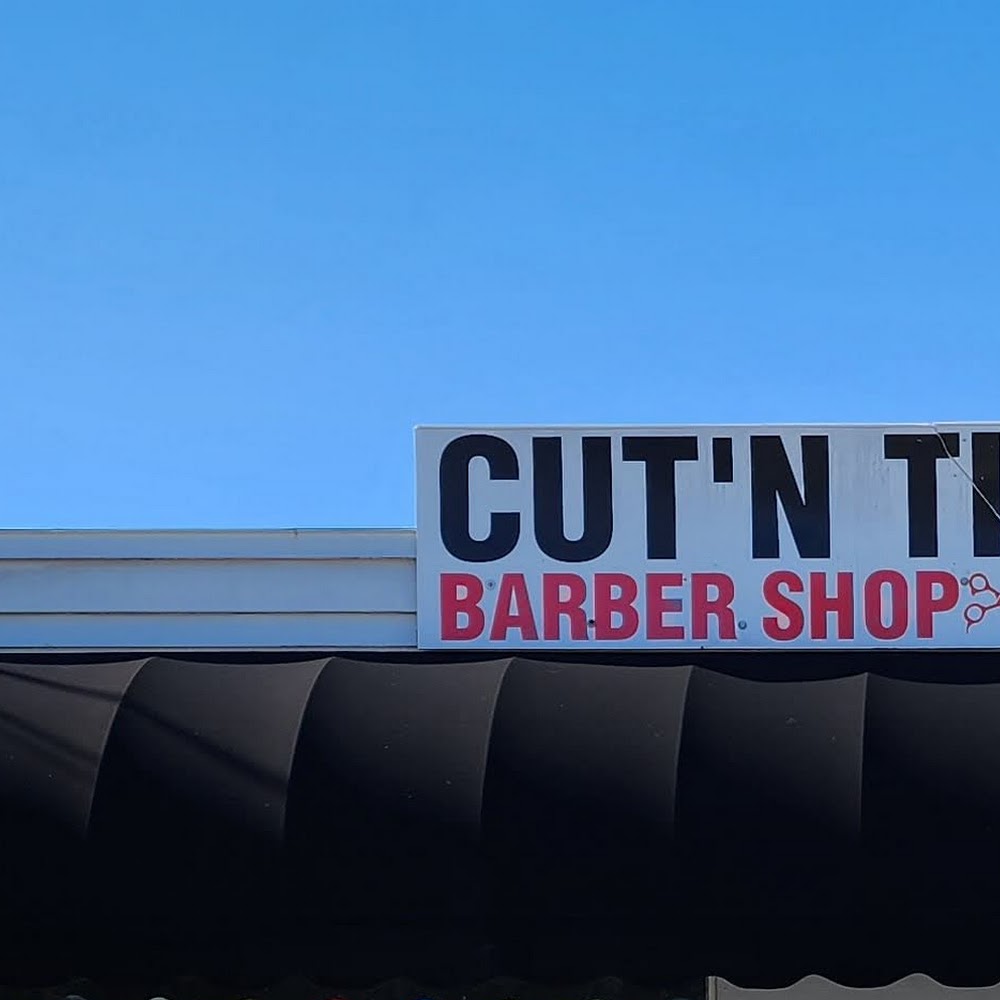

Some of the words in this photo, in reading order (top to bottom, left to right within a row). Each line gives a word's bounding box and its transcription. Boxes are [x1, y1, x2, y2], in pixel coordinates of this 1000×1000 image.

[439, 433, 831, 562] CUT'N
[440, 572, 738, 641] BARBER
[762, 569, 960, 641] SHOP
